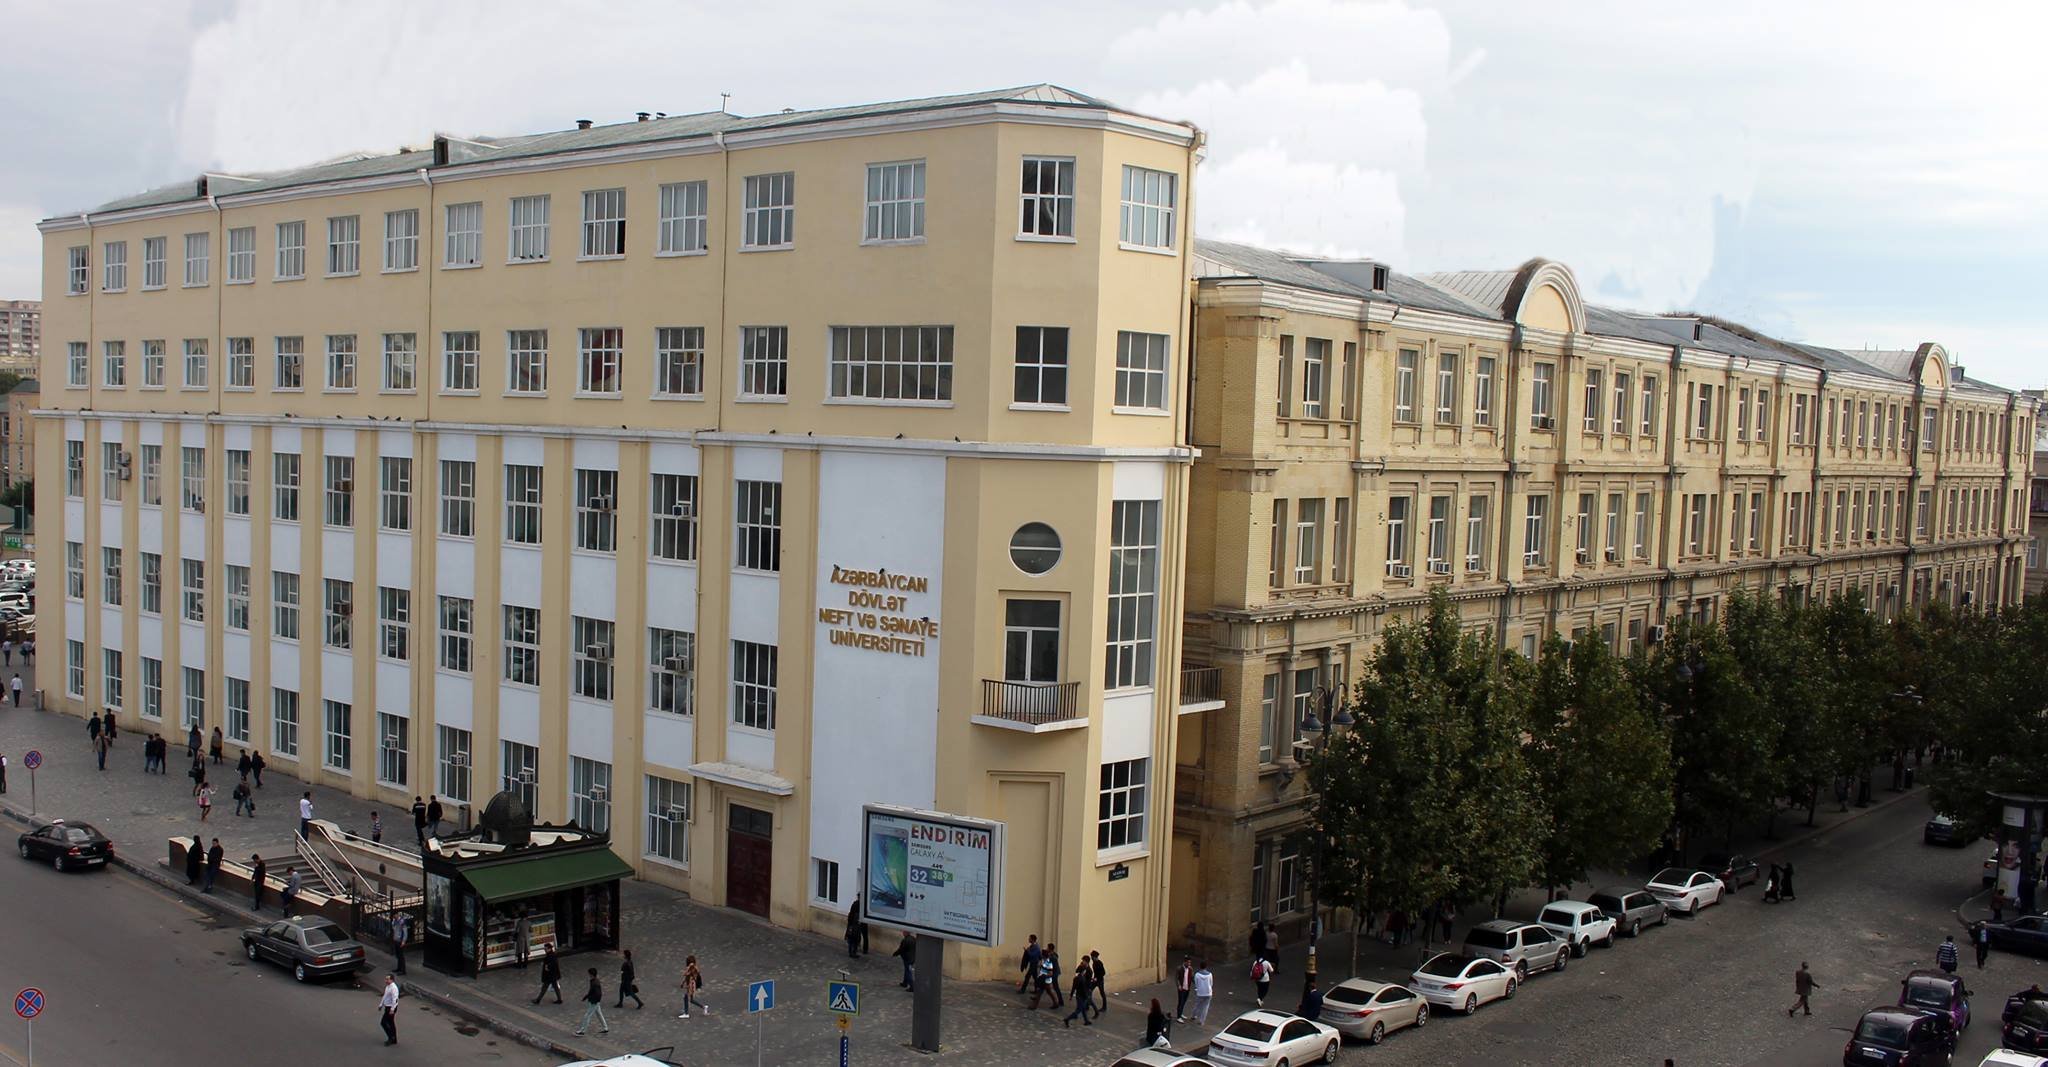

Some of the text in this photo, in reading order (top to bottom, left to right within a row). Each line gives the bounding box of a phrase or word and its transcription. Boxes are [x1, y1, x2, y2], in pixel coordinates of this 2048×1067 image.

[830, 568, 928, 593] AZƏRBAYCAN
[848, 589, 907, 612] DÖVLƏT
[818, 608, 938, 638] NEFT VƏ SƏNAYE
[829, 628, 926, 657] UNİVERSİTETİ
[911, 824, 988, 849] ENDİRİM
[911, 869, 928, 883] 32
